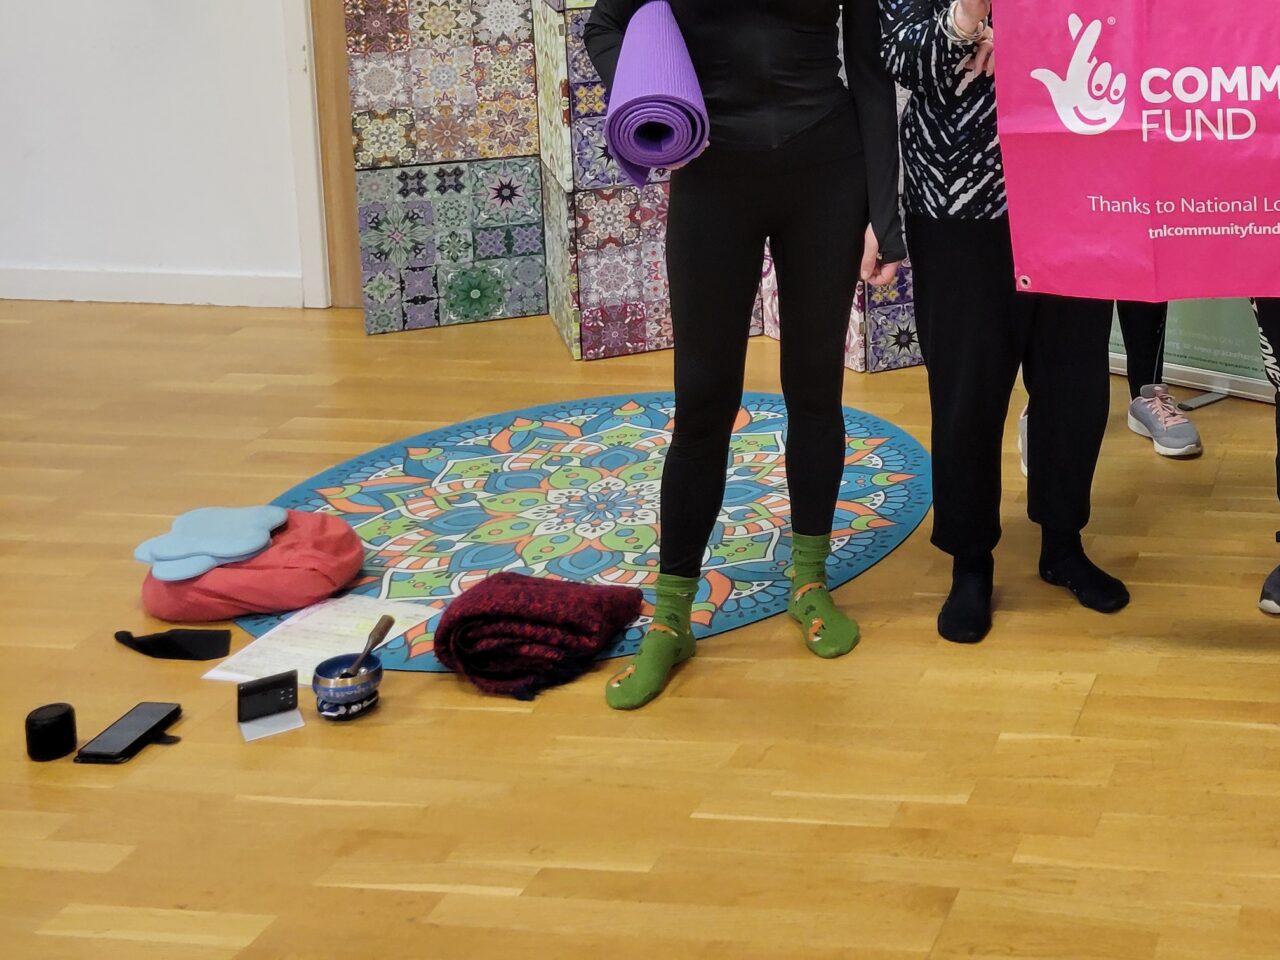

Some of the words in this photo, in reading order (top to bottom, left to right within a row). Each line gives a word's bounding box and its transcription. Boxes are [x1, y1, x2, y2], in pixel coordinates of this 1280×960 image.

[1141, 107, 1257, 142] FUND
[1087, 195, 1150, 215] Thanks
[1155, 200, 1176, 214] to
[1181, 196, 1257, 214] National
